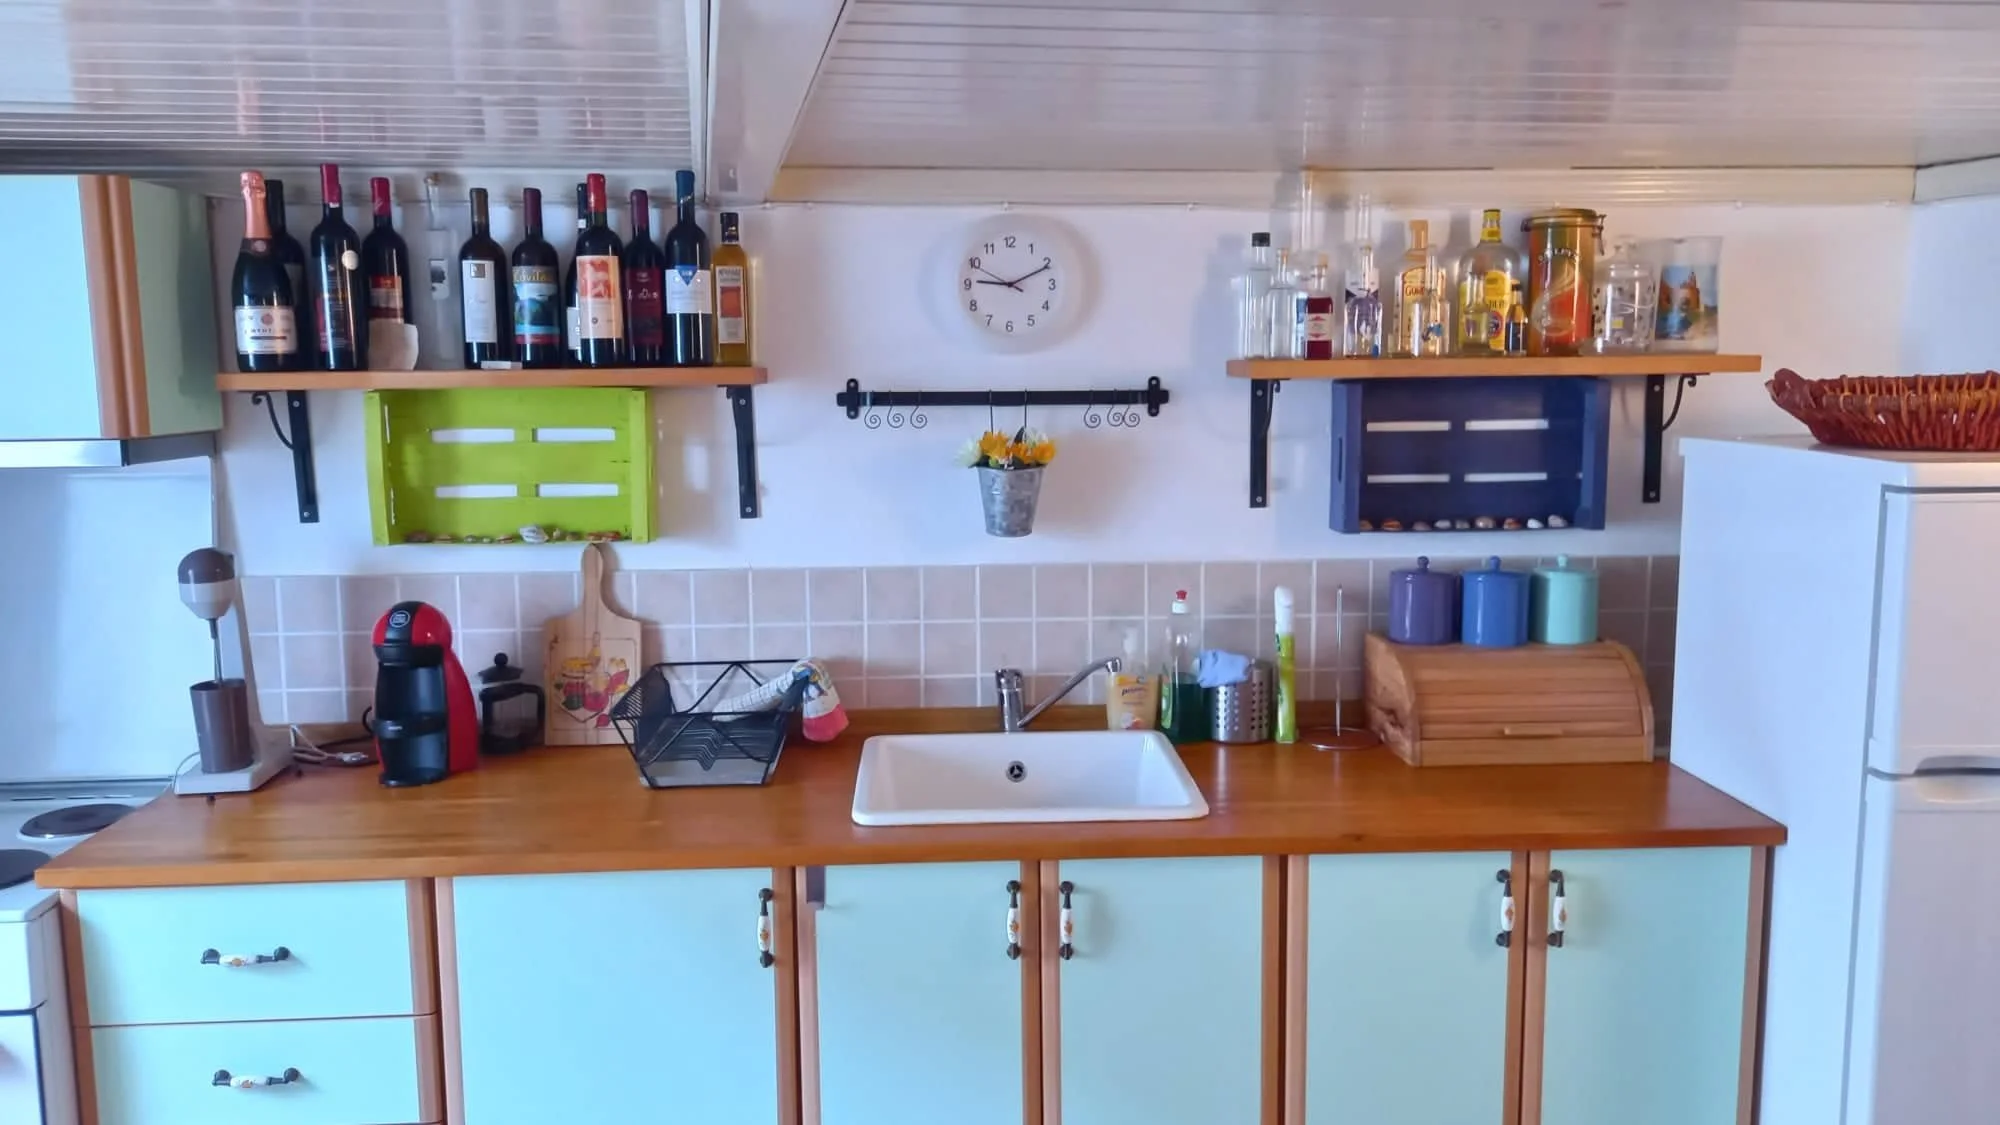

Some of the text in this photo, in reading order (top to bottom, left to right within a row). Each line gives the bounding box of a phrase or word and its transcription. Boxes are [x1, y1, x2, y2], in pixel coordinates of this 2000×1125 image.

[1004, 236, 1016, 248] 12
[984, 243, 995, 254] 11
[1028, 243, 1033, 254] 1
[969, 257, 981, 269] 10
[1043, 257, 1051, 269] 2
[964, 278, 972, 290] 9
[1048, 278, 1056, 291] 3
[969, 299, 977, 312] 8
[1041, 300, 1049, 311] 4
[985, 314, 993, 326] 7
[1027, 315, 1035, 326] 5
[1005, 321, 1013, 332] 6
